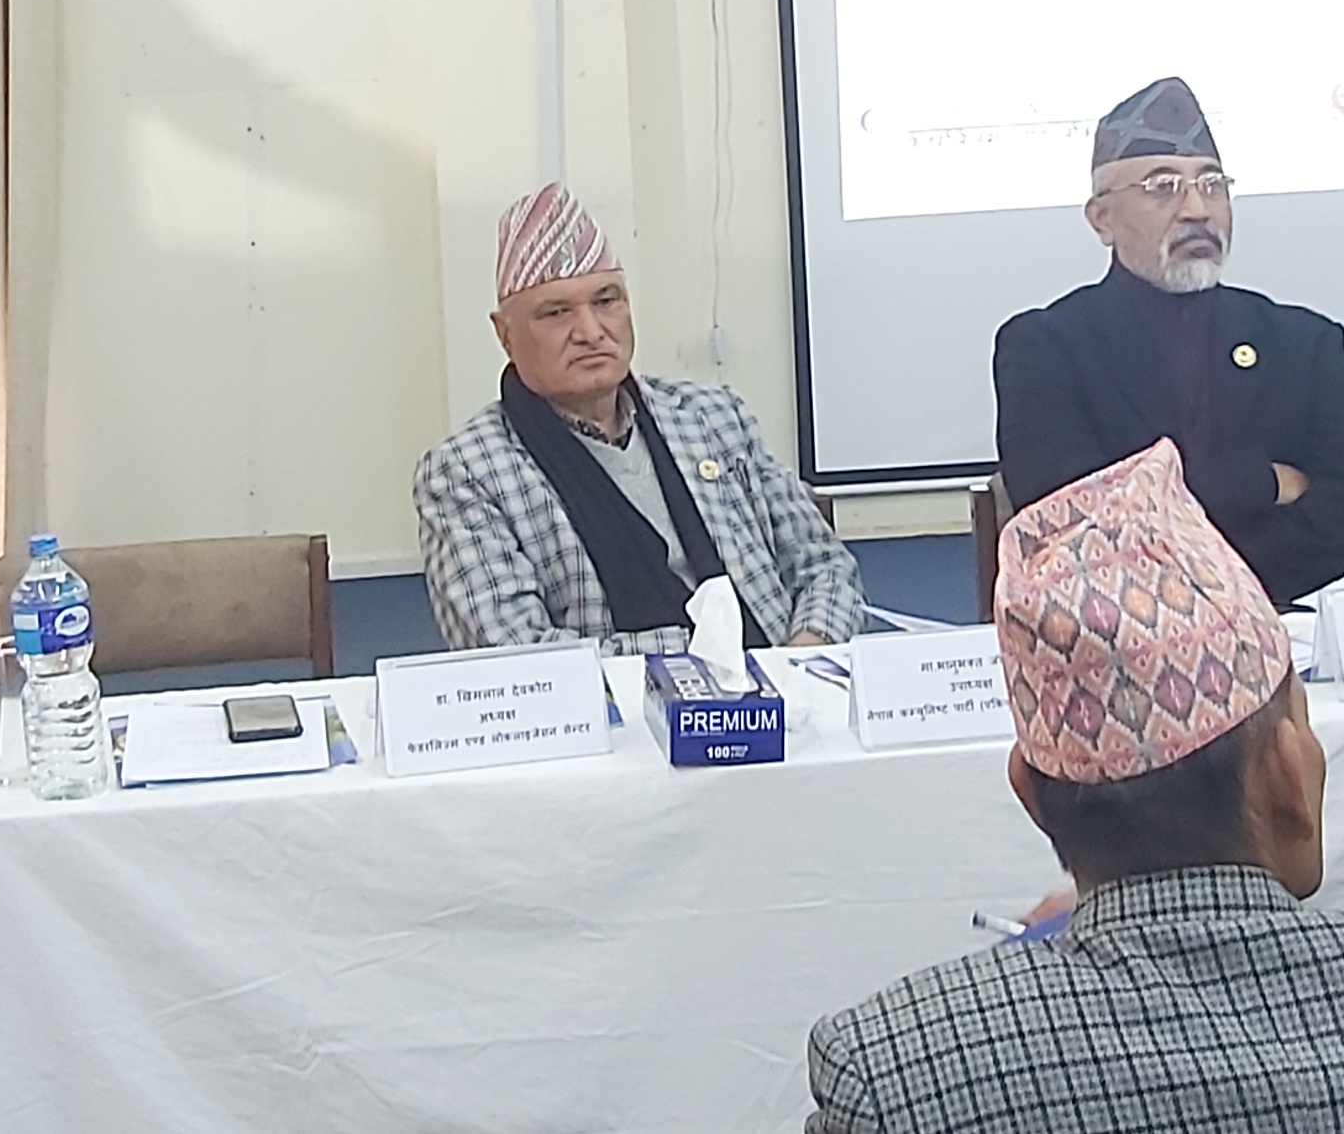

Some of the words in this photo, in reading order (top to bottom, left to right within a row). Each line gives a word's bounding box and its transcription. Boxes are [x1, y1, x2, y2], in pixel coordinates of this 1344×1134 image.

[511, 681, 554, 698] देवकोटा
[679, 708, 779, 733] PREMIUM
[707, 746, 729, 760] 100
